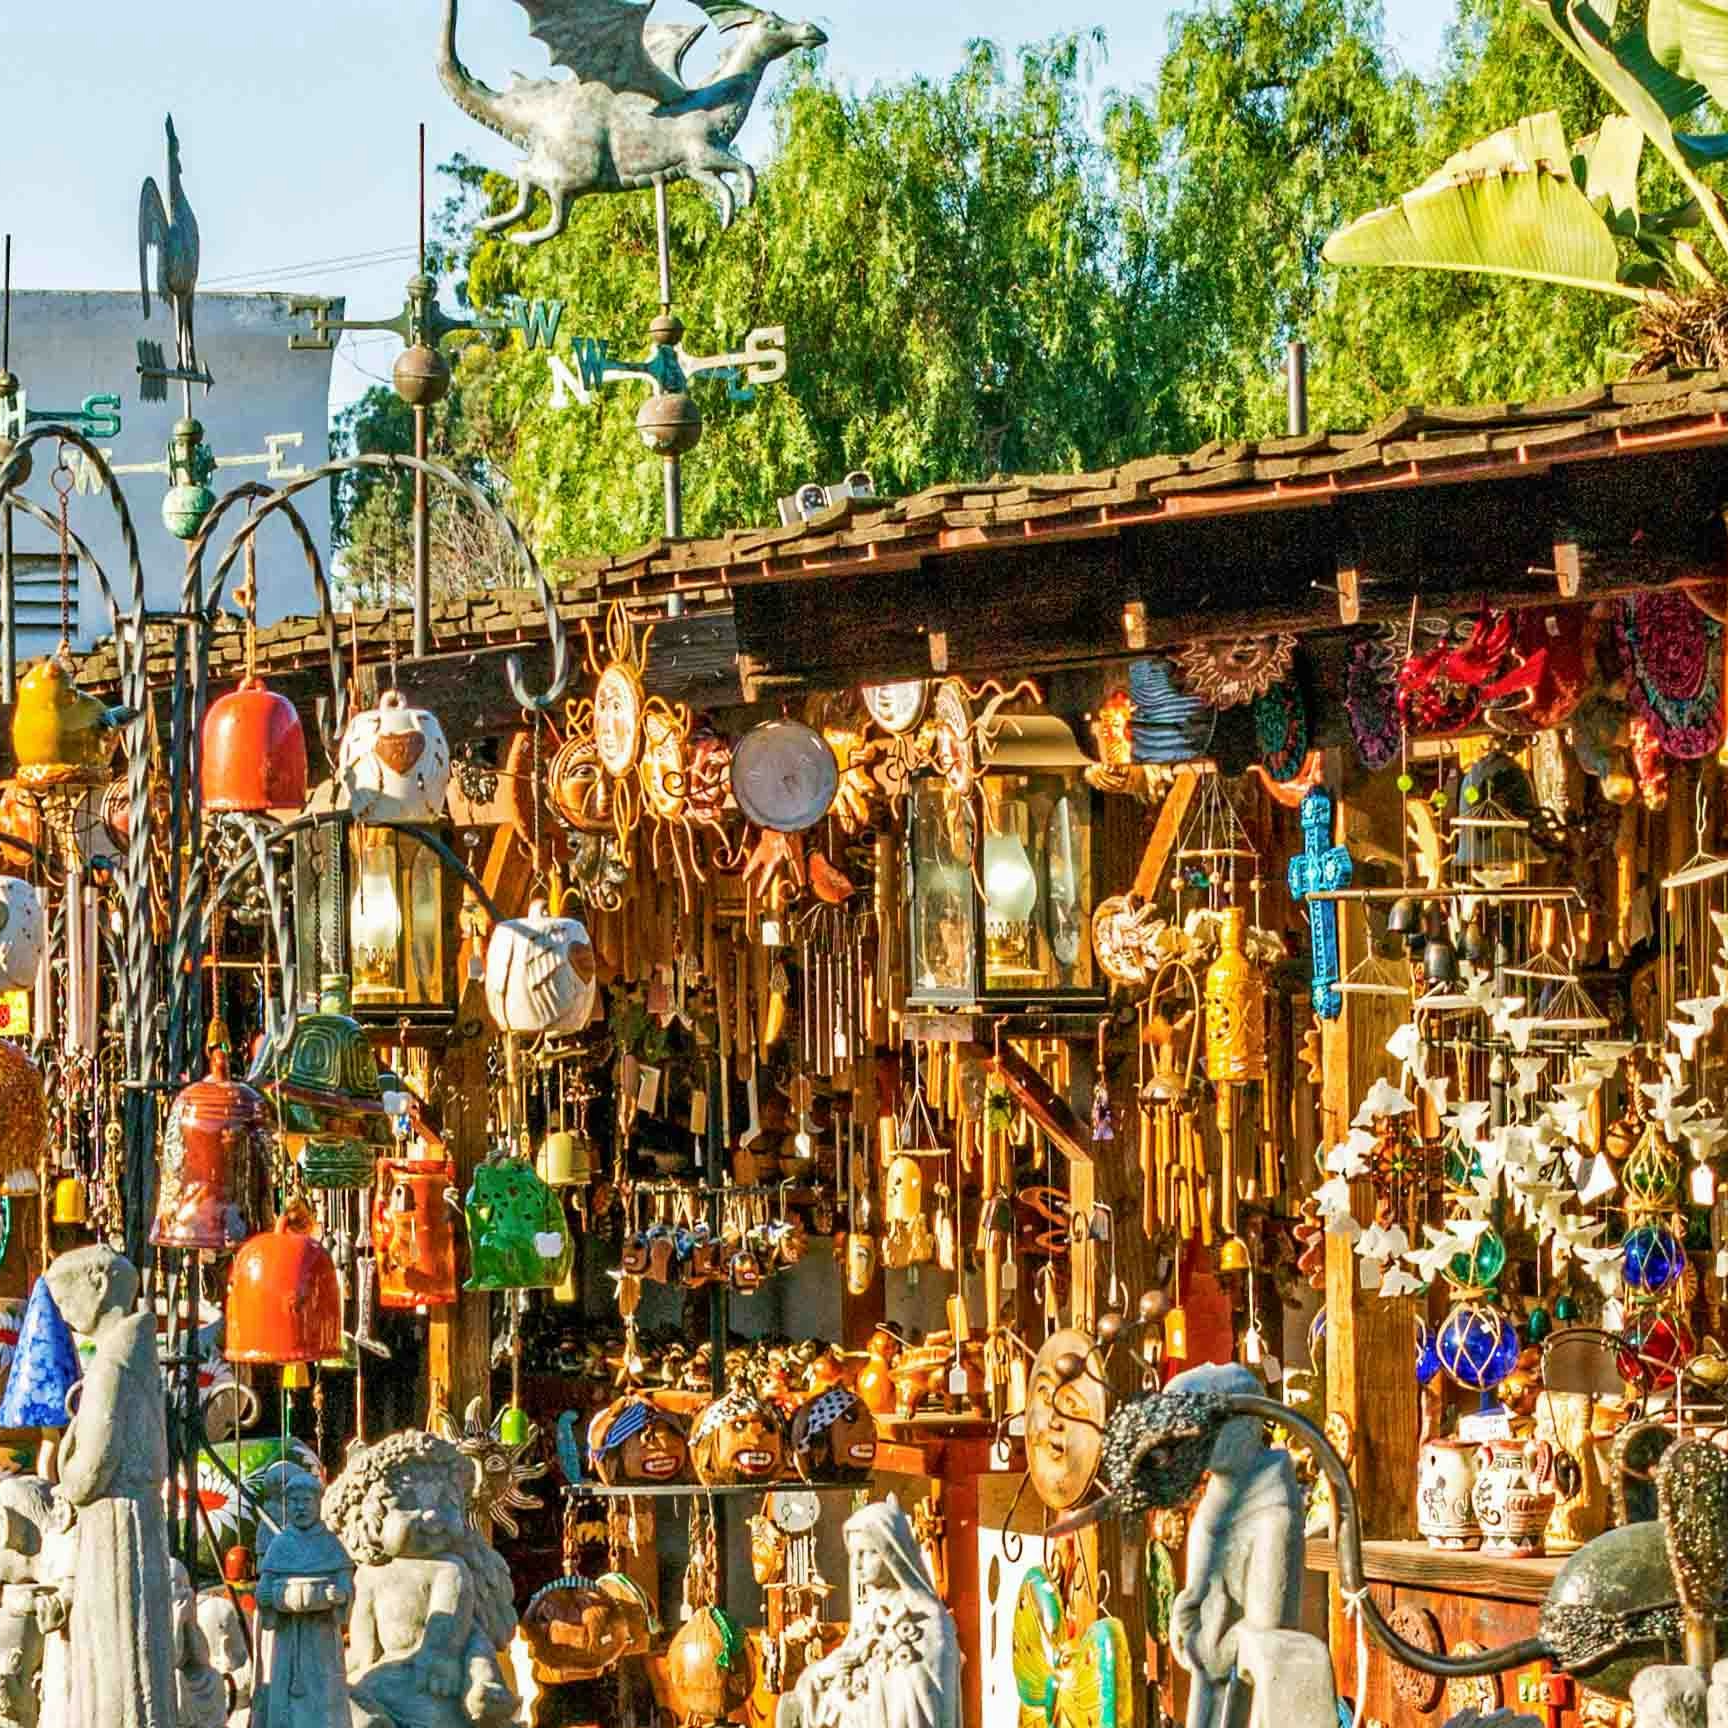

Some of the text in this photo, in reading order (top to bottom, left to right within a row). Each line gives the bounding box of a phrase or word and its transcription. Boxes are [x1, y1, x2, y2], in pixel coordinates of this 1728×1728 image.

[515, 300, 564, 349] W
[574, 336, 610, 391] W
[745, 325, 786, 385] S
[547, 355, 591, 409] N
[82, 393, 121, 438] S
[264, 431, 304, 480] E
